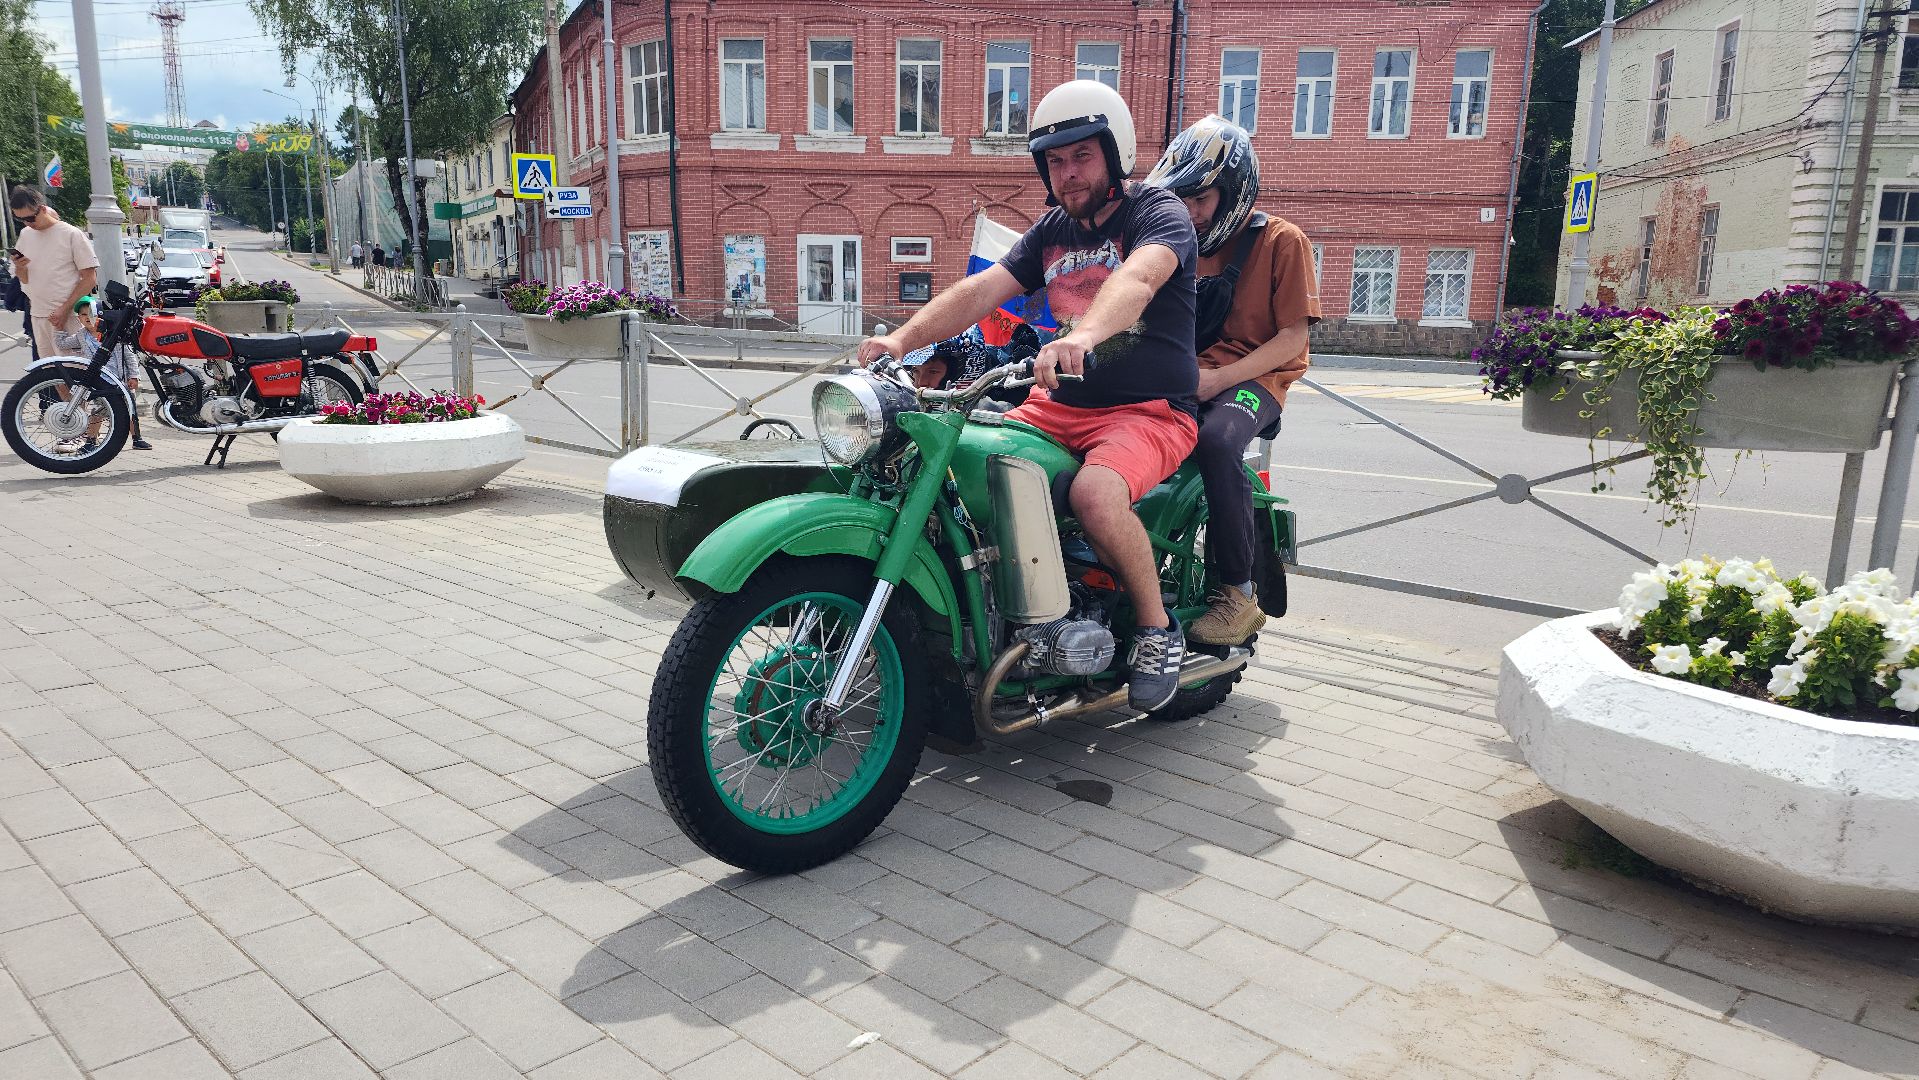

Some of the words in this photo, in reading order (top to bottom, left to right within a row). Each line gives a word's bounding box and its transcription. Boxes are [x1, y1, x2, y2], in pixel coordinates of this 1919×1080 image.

[133, 130, 206, 144] Волоколамск
[208, 135, 233, 145] 1135
[561, 207, 590, 215] МОСКВА
